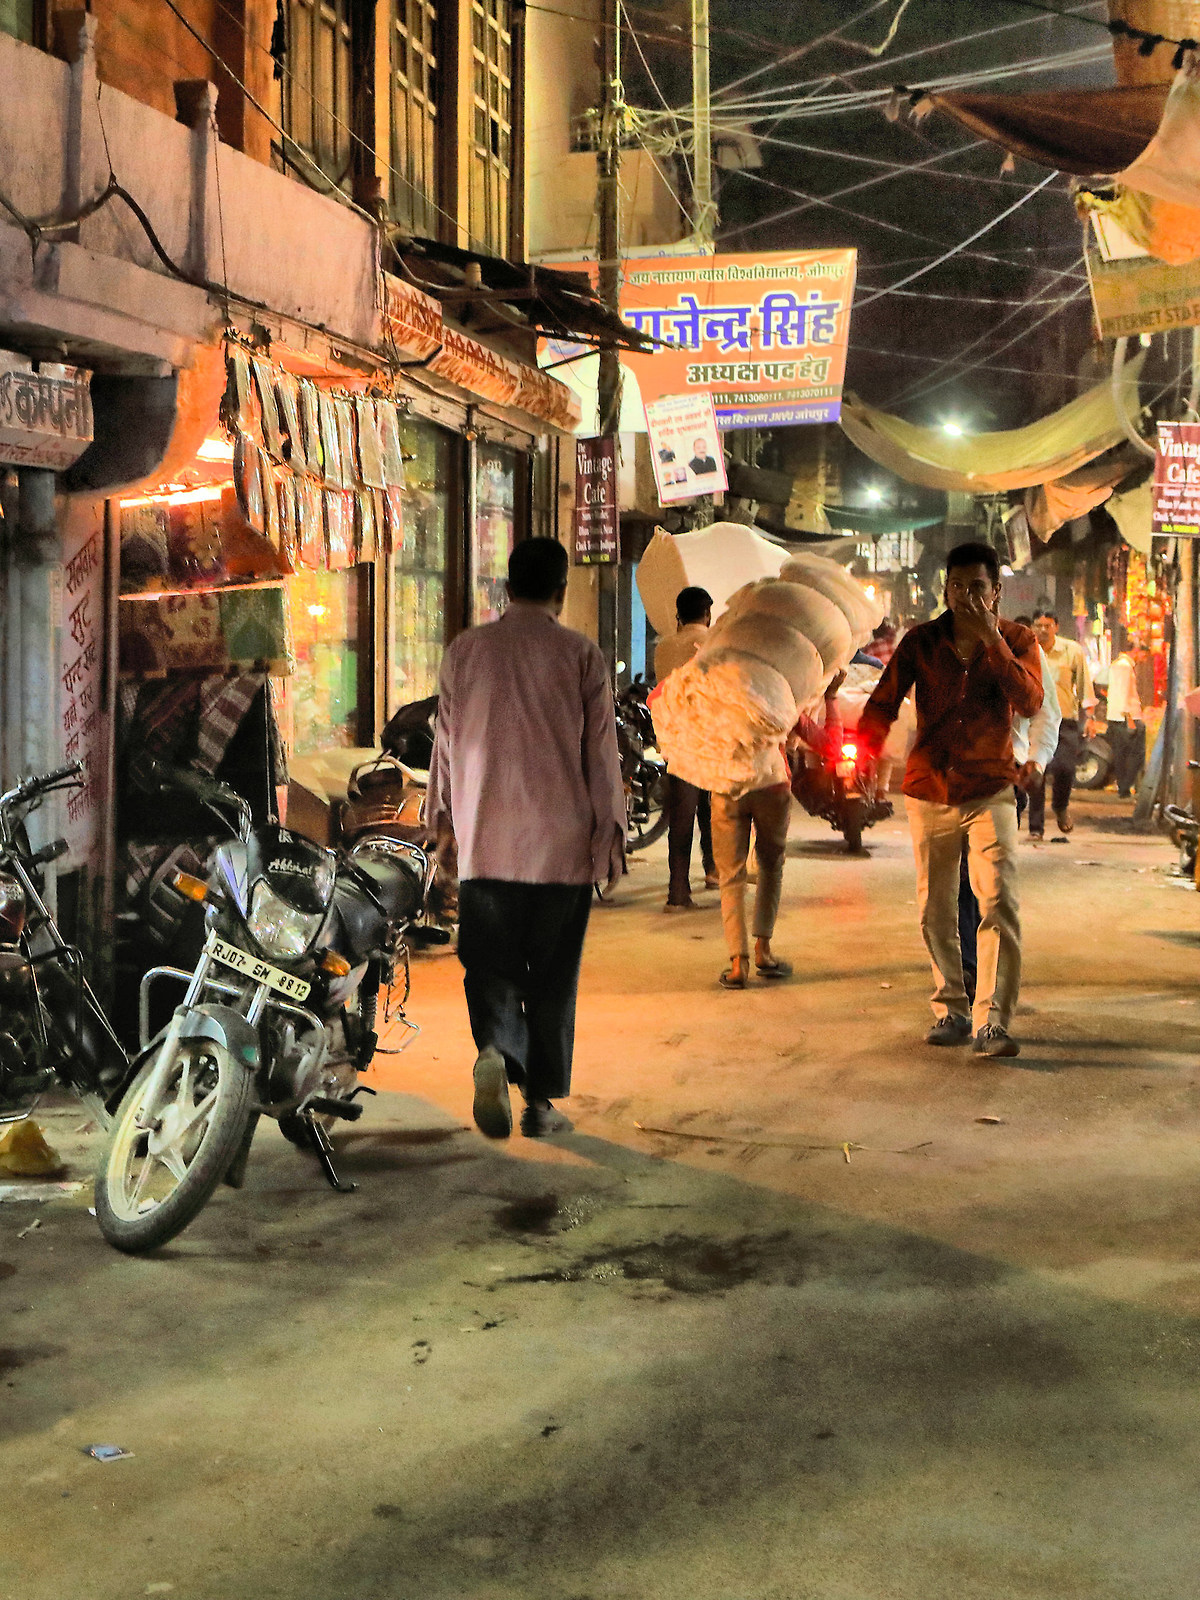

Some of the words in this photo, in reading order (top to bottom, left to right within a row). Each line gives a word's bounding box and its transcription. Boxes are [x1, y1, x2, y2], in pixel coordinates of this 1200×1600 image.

[630, 271, 650, 286] जय
[651, 268, 696, 286] नारायण
[699, 266, 725, 282] व्यास
[727, 263, 803, 281] विश्वविद्यालय,
[806, 261, 845, 281] जोधपुर
[625, 296, 752, 351] राजेन्द्र
[759, 293, 840, 348] सिंह
[688, 362, 761, 383] अध्यक्ष
[764, 360, 796, 381] पद
[799, 355, 831, 383] हेतु
[577, 453, 613, 481] Vintage
[584, 482, 606, 505] Cafe
[213, 943, 244, 967] RJ07
[252, 964, 271, 980] SM
